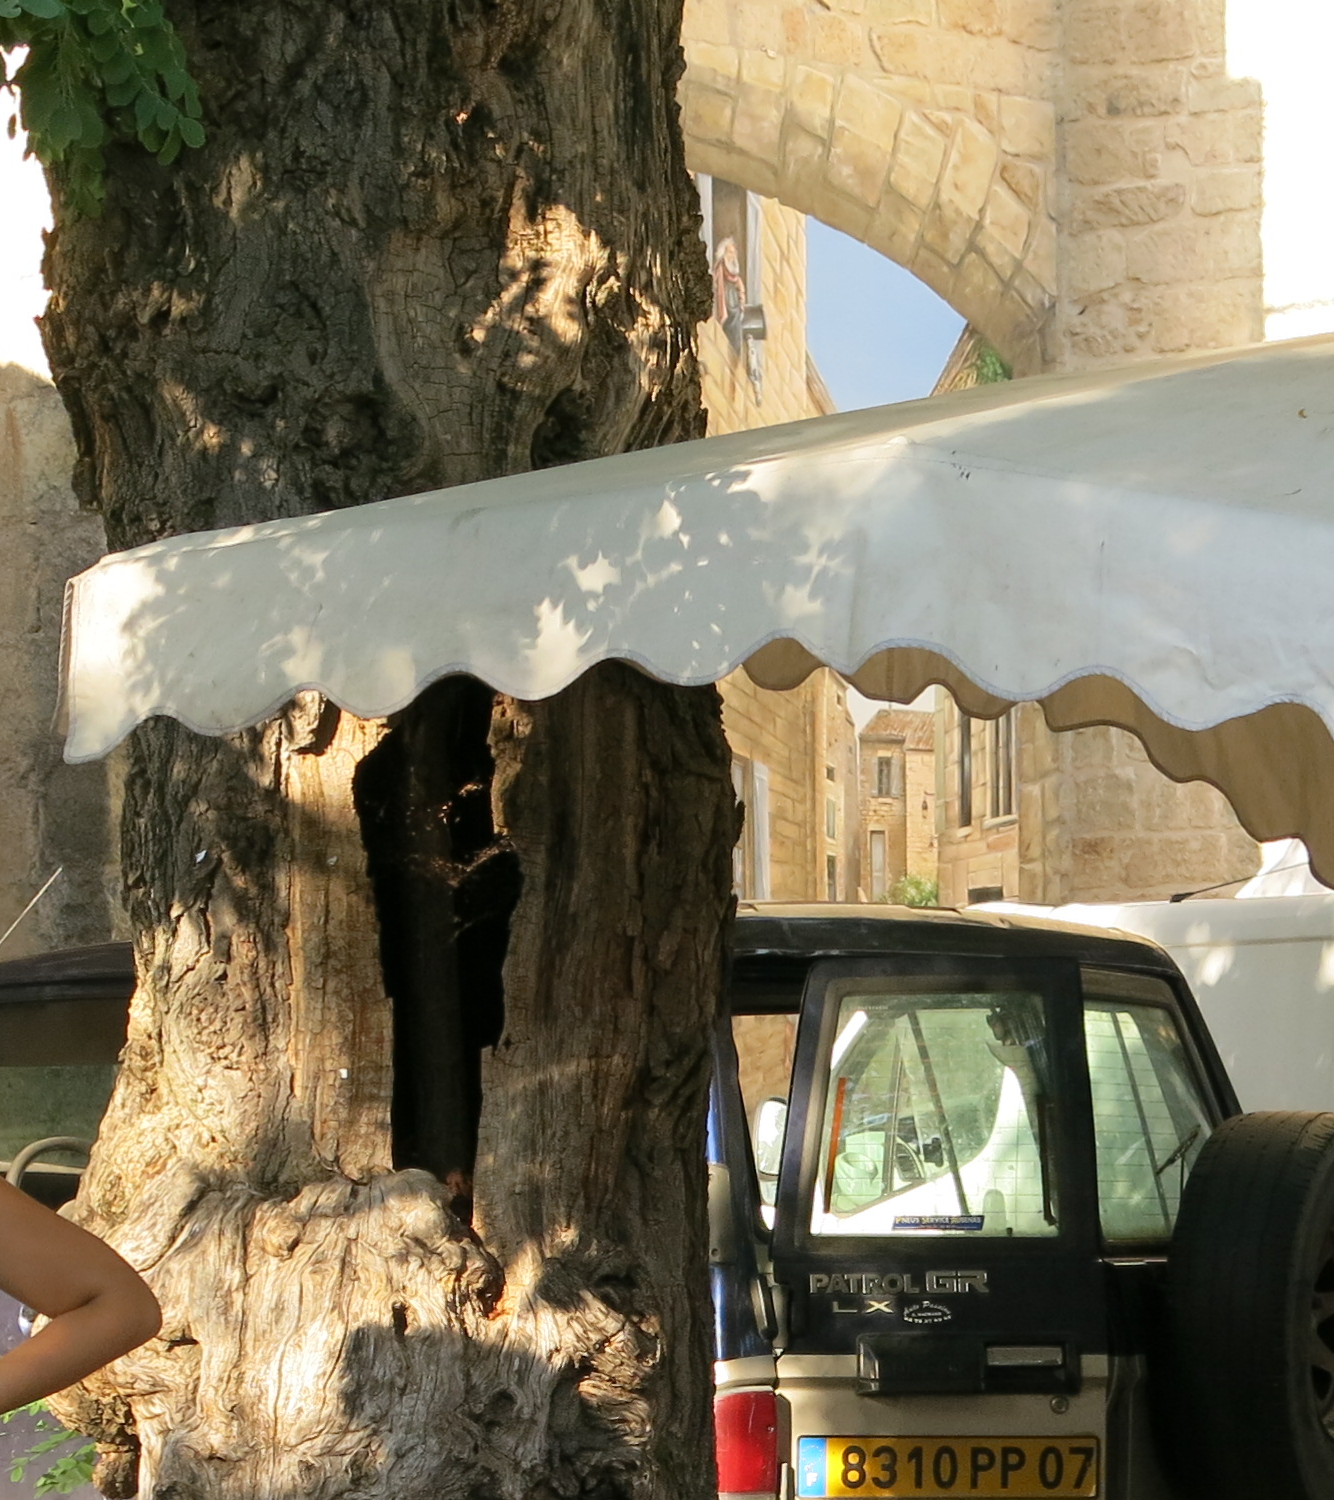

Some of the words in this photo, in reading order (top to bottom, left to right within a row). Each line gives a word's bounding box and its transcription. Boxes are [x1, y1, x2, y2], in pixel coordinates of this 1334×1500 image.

[895, 1216, 920, 1224] PNEUS
[921, 1216, 949, 1224] SERVICE
[809, 1272, 920, 1295] PATROL
[925, 1269, 989, 1294] GR
[841, 1445, 958, 1490] 8310
[969, 1446, 1027, 1490] PP
[1037, 1446, 1095, 1490] 07
